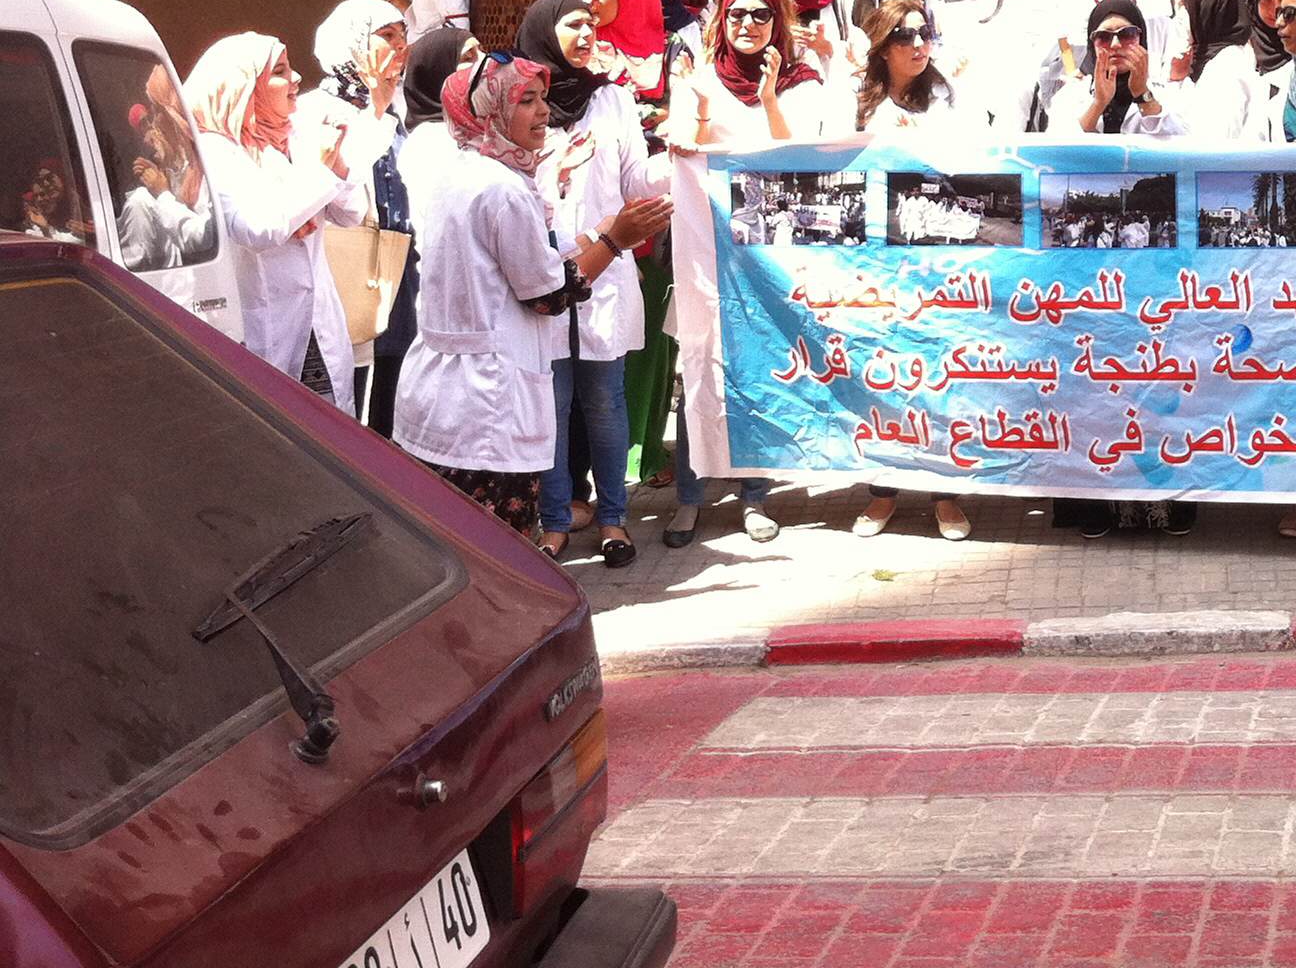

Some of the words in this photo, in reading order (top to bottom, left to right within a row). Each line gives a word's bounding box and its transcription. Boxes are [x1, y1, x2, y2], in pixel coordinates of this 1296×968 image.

[790, 265, 991, 322] التمريضية
[1010, 271, 1123, 322] للمهن
[1139, 270, 1251, 331] العالي
[773, 334, 848, 382] قرار
[864, 343, 1058, 394] يستنكرون
[1073, 334, 1197, 393] بطنجة
[854, 409, 930, 456] العام
[949, 410, 1070, 467] القطاع
[1089, 408, 1144, 472] في
[437, 861, 478, 950] 40
